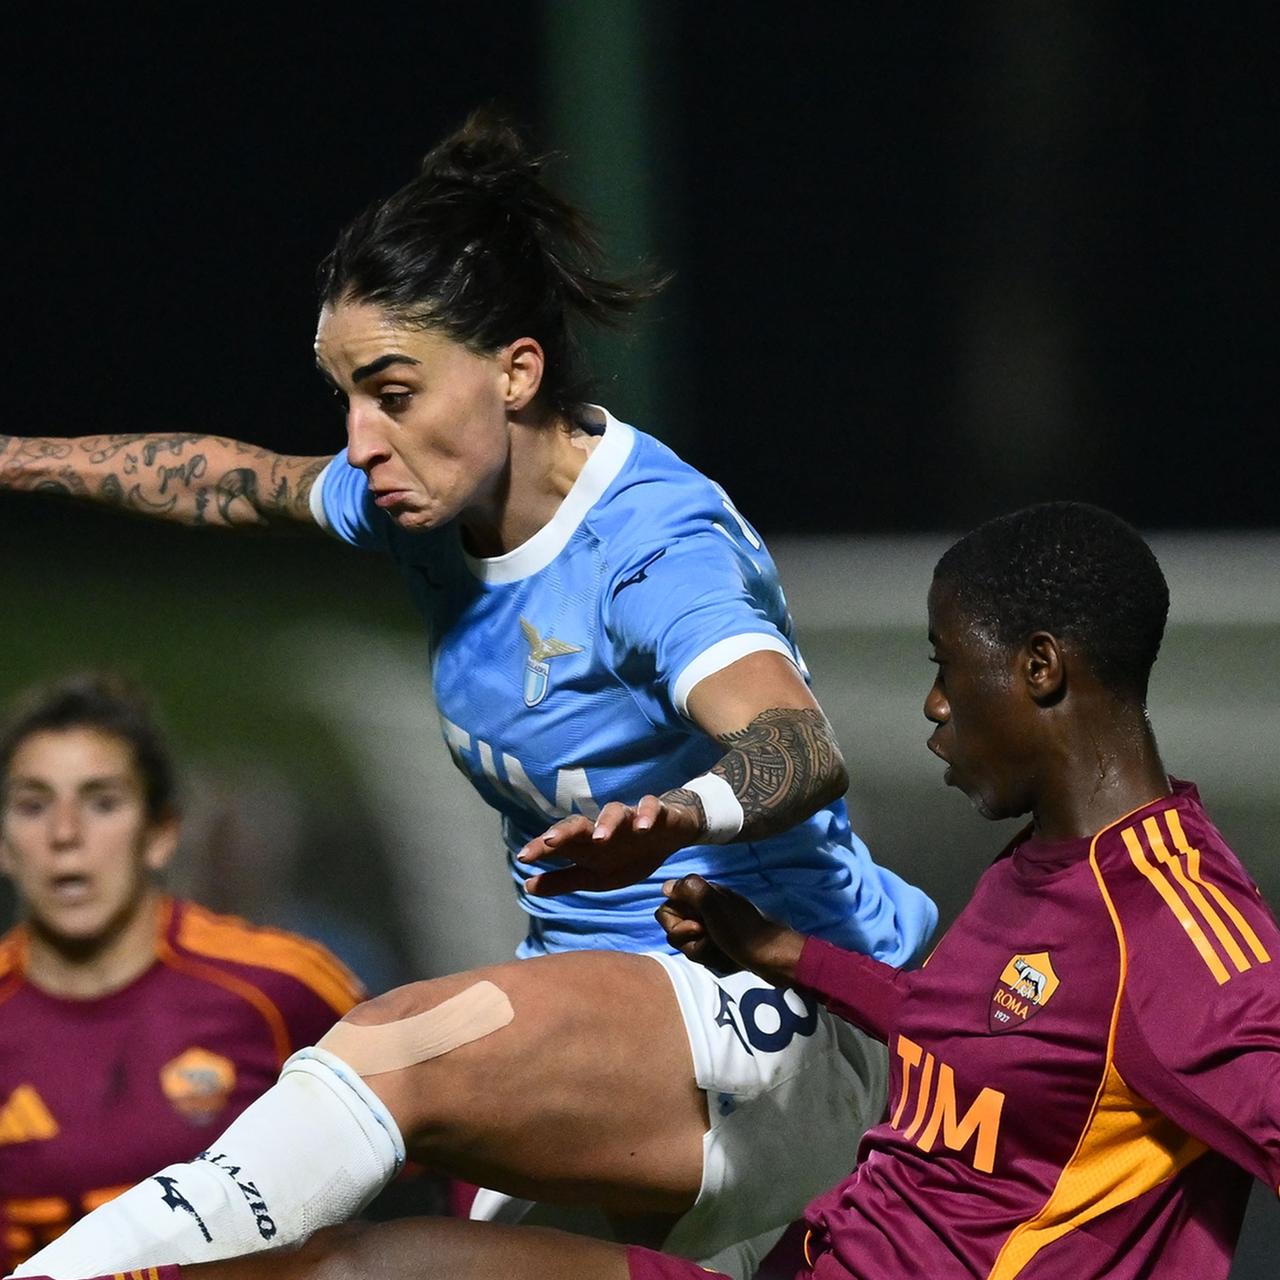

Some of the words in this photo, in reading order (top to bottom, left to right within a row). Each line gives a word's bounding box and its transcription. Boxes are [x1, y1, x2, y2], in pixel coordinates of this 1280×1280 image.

[440, 716, 601, 821] TIM
[738, 987, 818, 1053] 8
[993, 988, 1029, 1020] ROMA
[891, 1034, 1006, 1174] TIM
